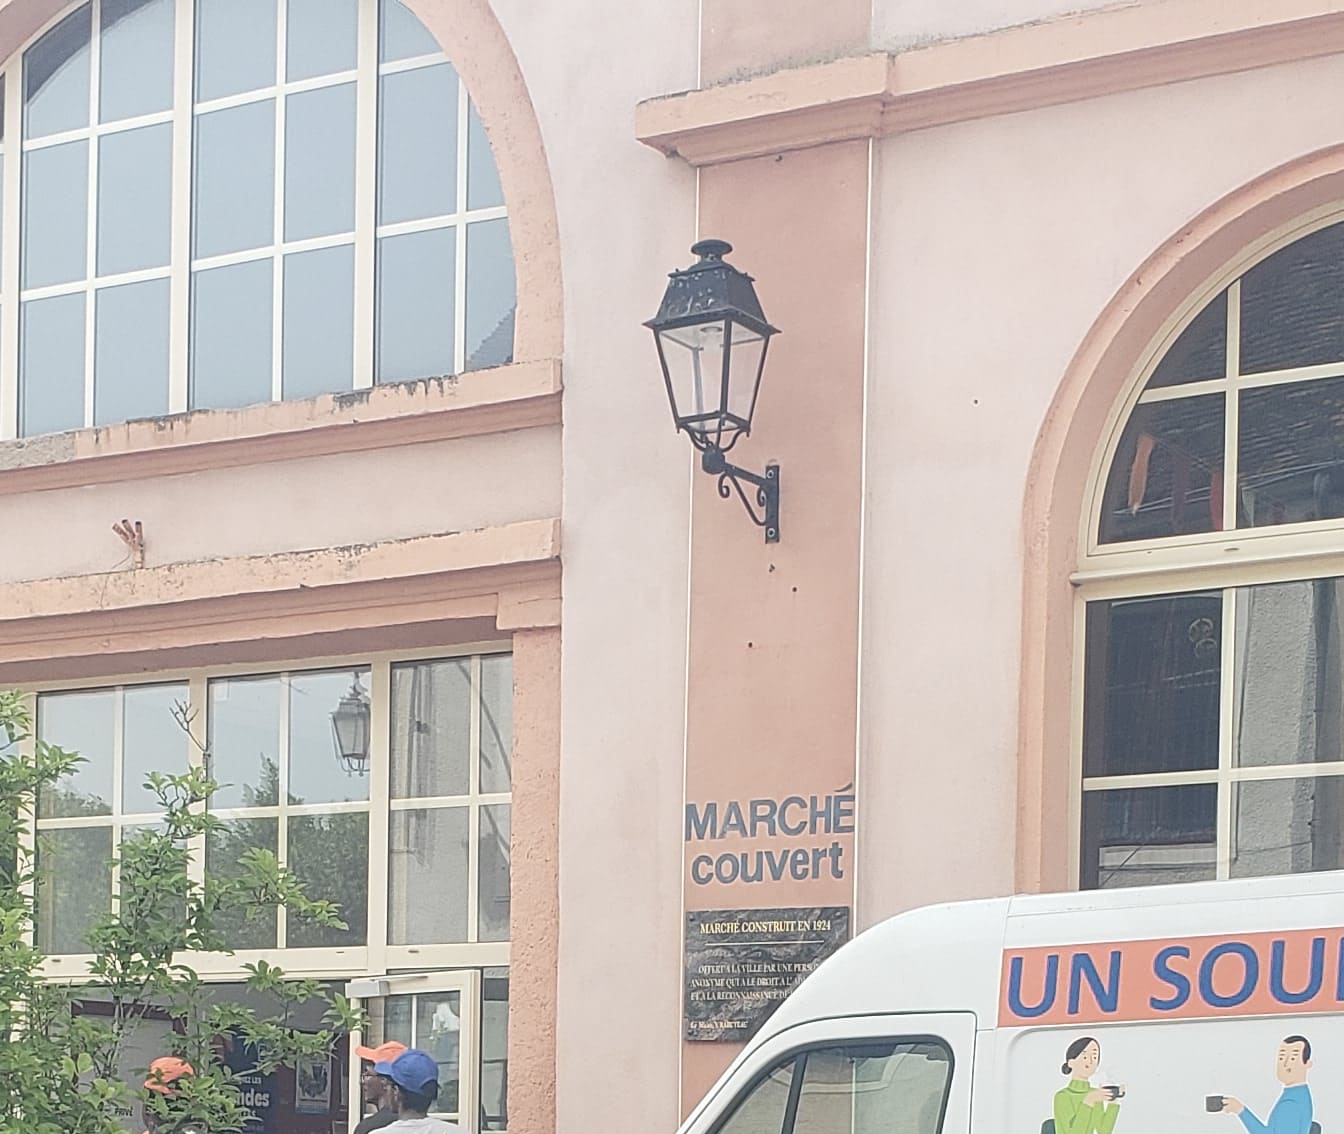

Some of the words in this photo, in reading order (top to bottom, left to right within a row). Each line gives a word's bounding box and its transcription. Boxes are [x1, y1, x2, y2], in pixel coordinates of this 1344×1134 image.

[686, 782, 855, 842] MARCHÉ
[692, 841, 844, 885] couvert
[742, 921, 796, 933] CONSTRUIT
[798, 921, 810, 931] EN
[813, 920, 831, 931] 1924
[1007, 950, 1122, 1019] UN
